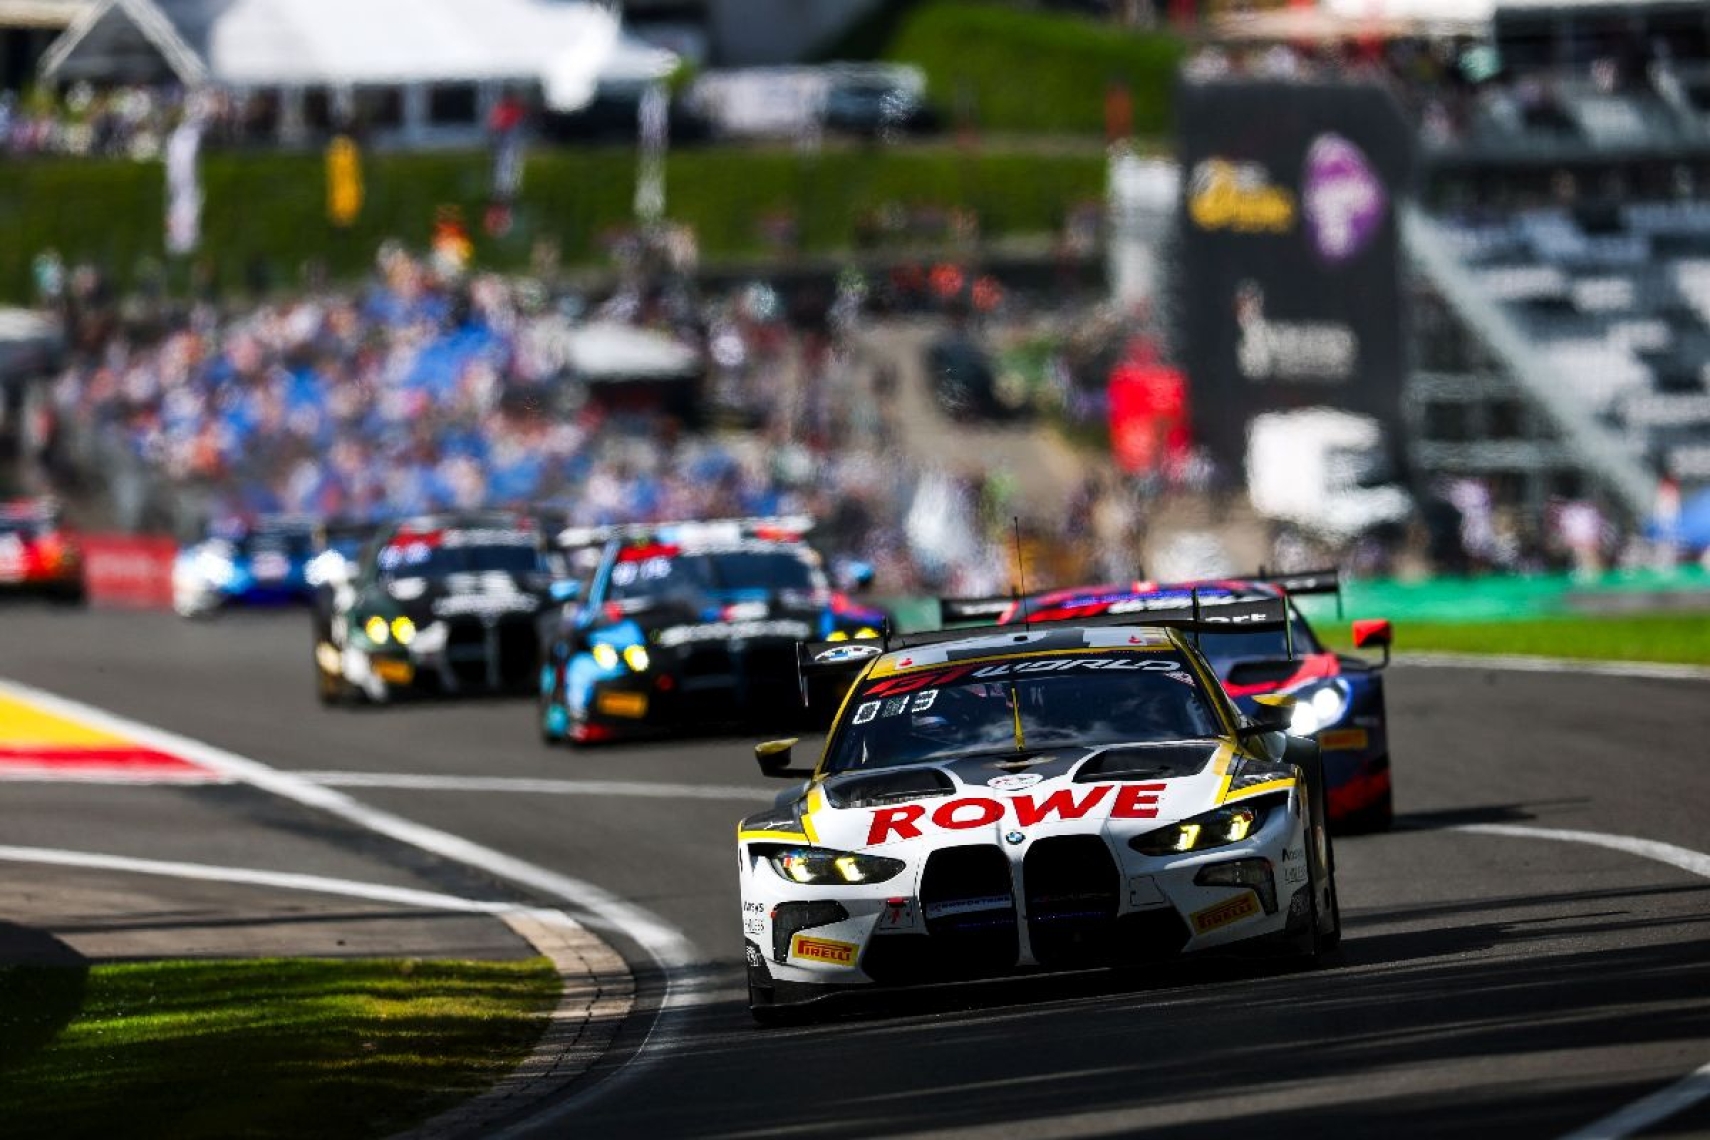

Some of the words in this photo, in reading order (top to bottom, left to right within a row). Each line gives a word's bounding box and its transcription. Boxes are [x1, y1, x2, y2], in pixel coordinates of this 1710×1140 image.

[972, 658, 1181, 678] WORLD
[866, 783, 1167, 845] ROWE
[797, 938, 854, 961] PIRELLI
